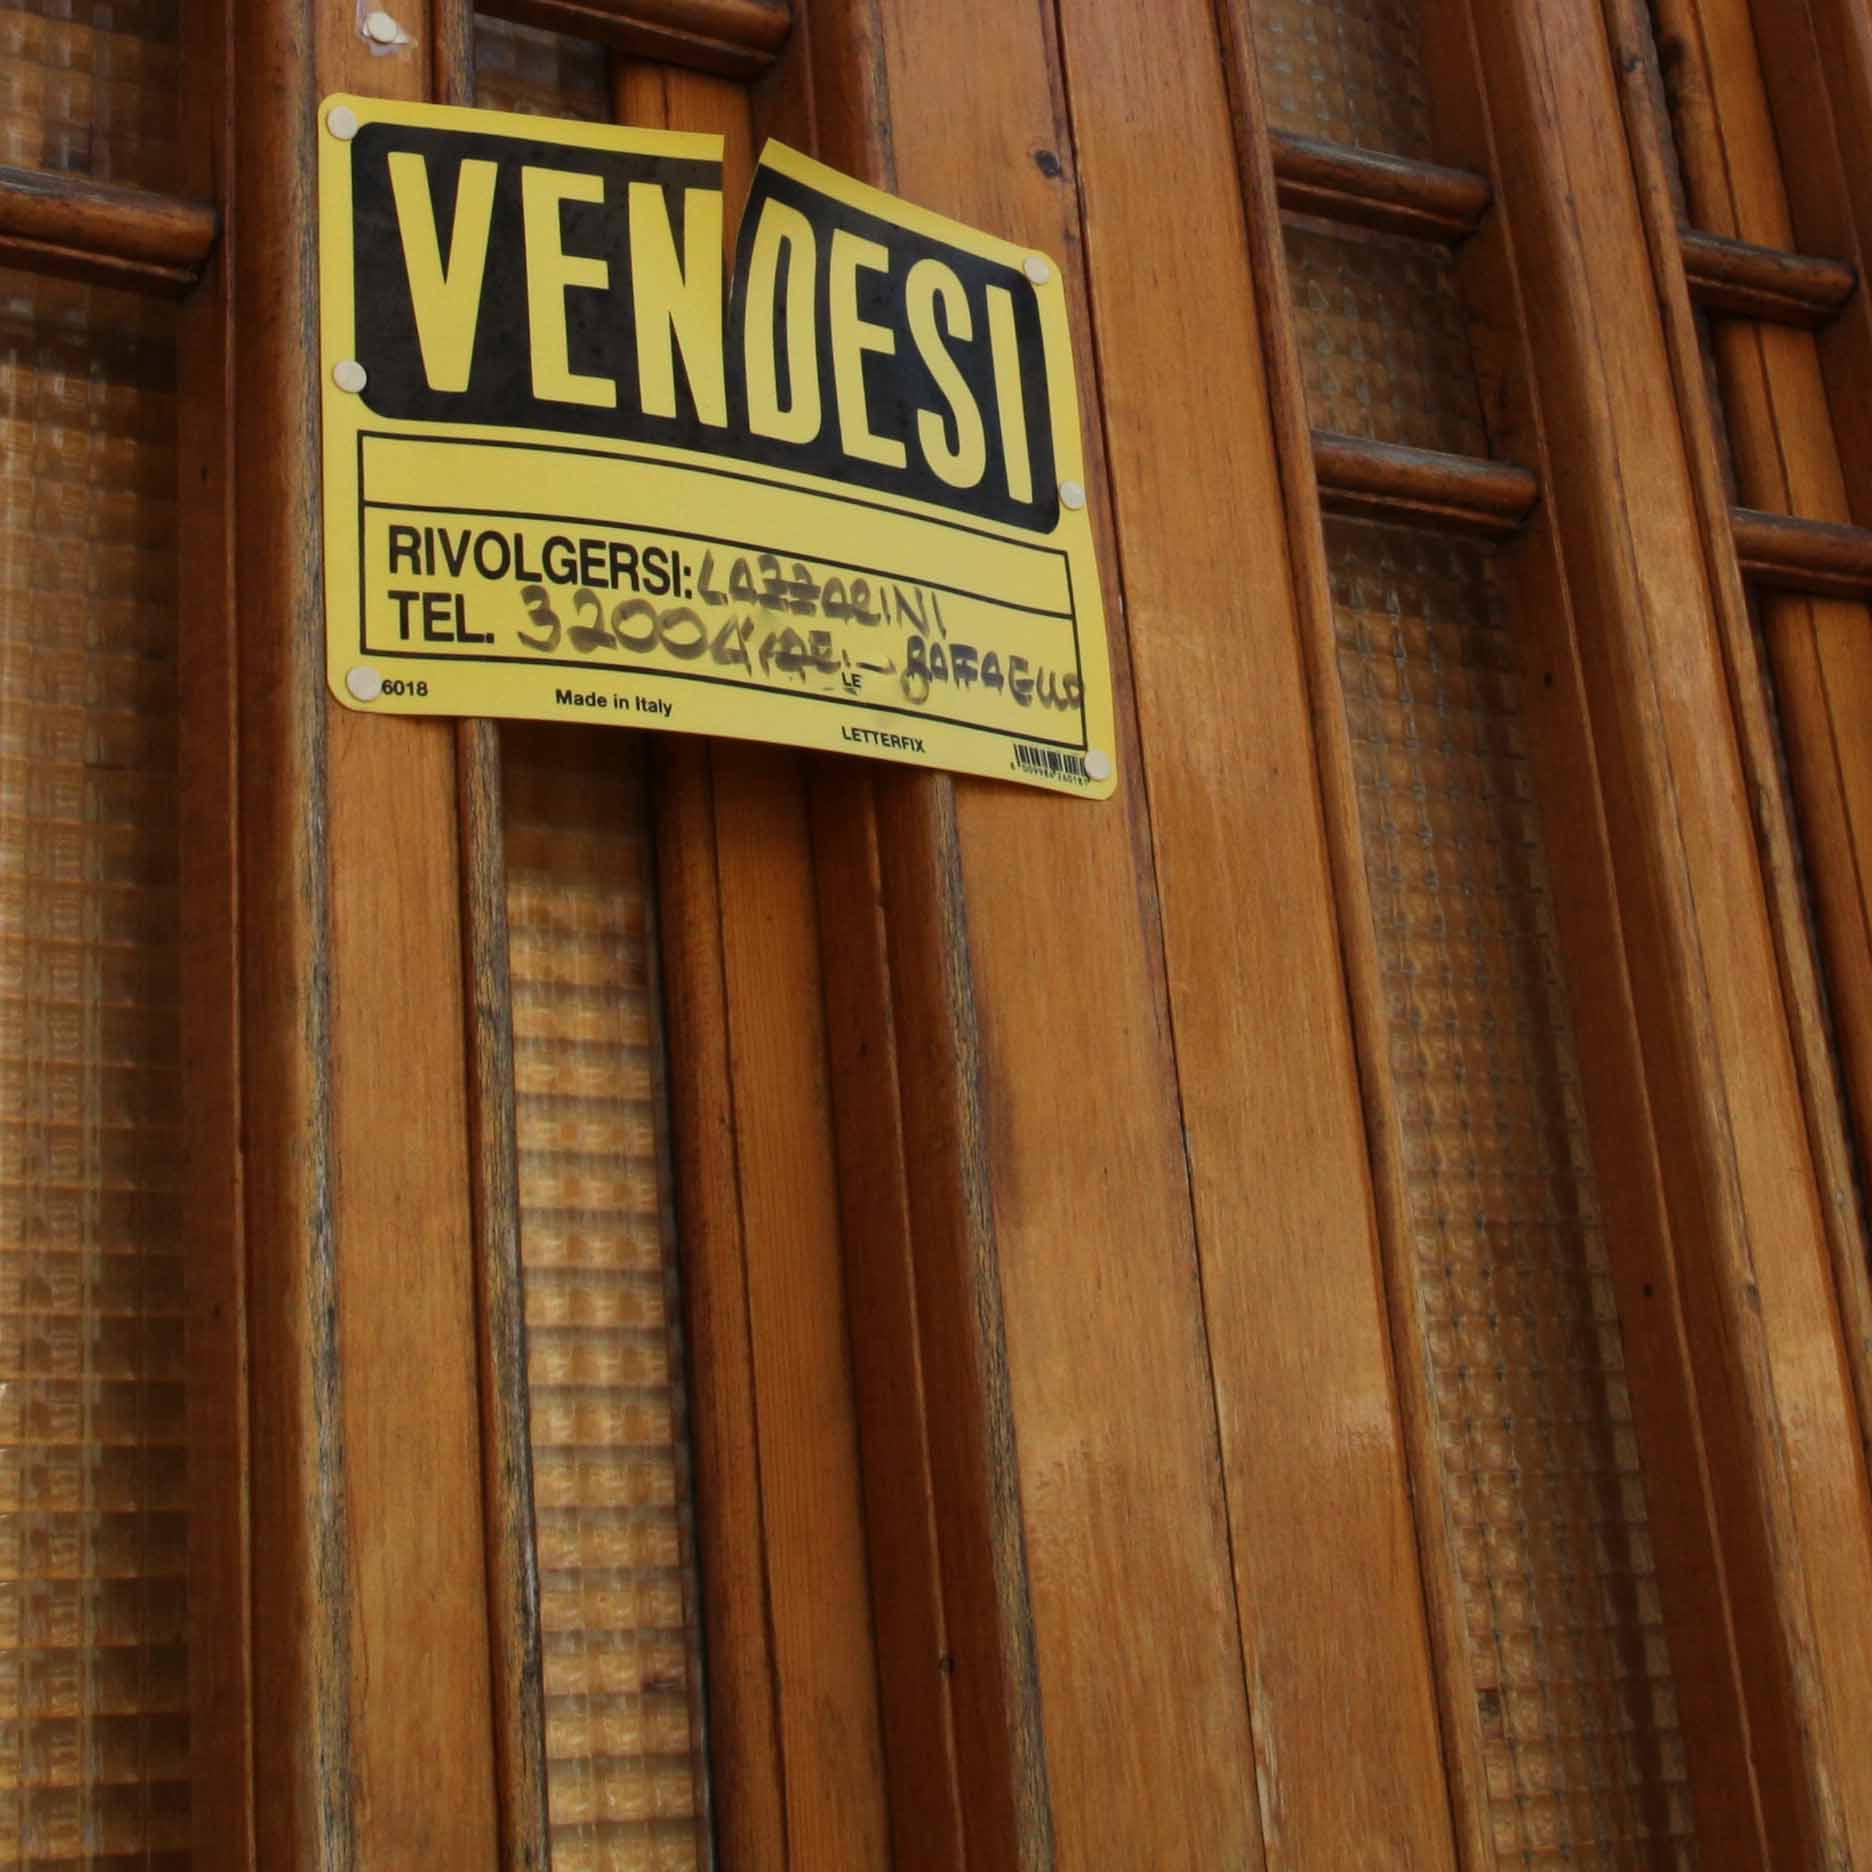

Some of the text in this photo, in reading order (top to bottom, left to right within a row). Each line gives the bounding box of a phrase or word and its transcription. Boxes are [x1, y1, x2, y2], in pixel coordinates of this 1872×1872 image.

[387, 150, 1034, 505] VENDESI
[388, 525, 694, 600] RIVOLGERSI:
[387, 590, 495, 644] TEL.
[381, 680, 429, 697] 6018
[555, 689, 674, 717] Made in Italy
[841, 725, 926, 754] LETTERFIX
